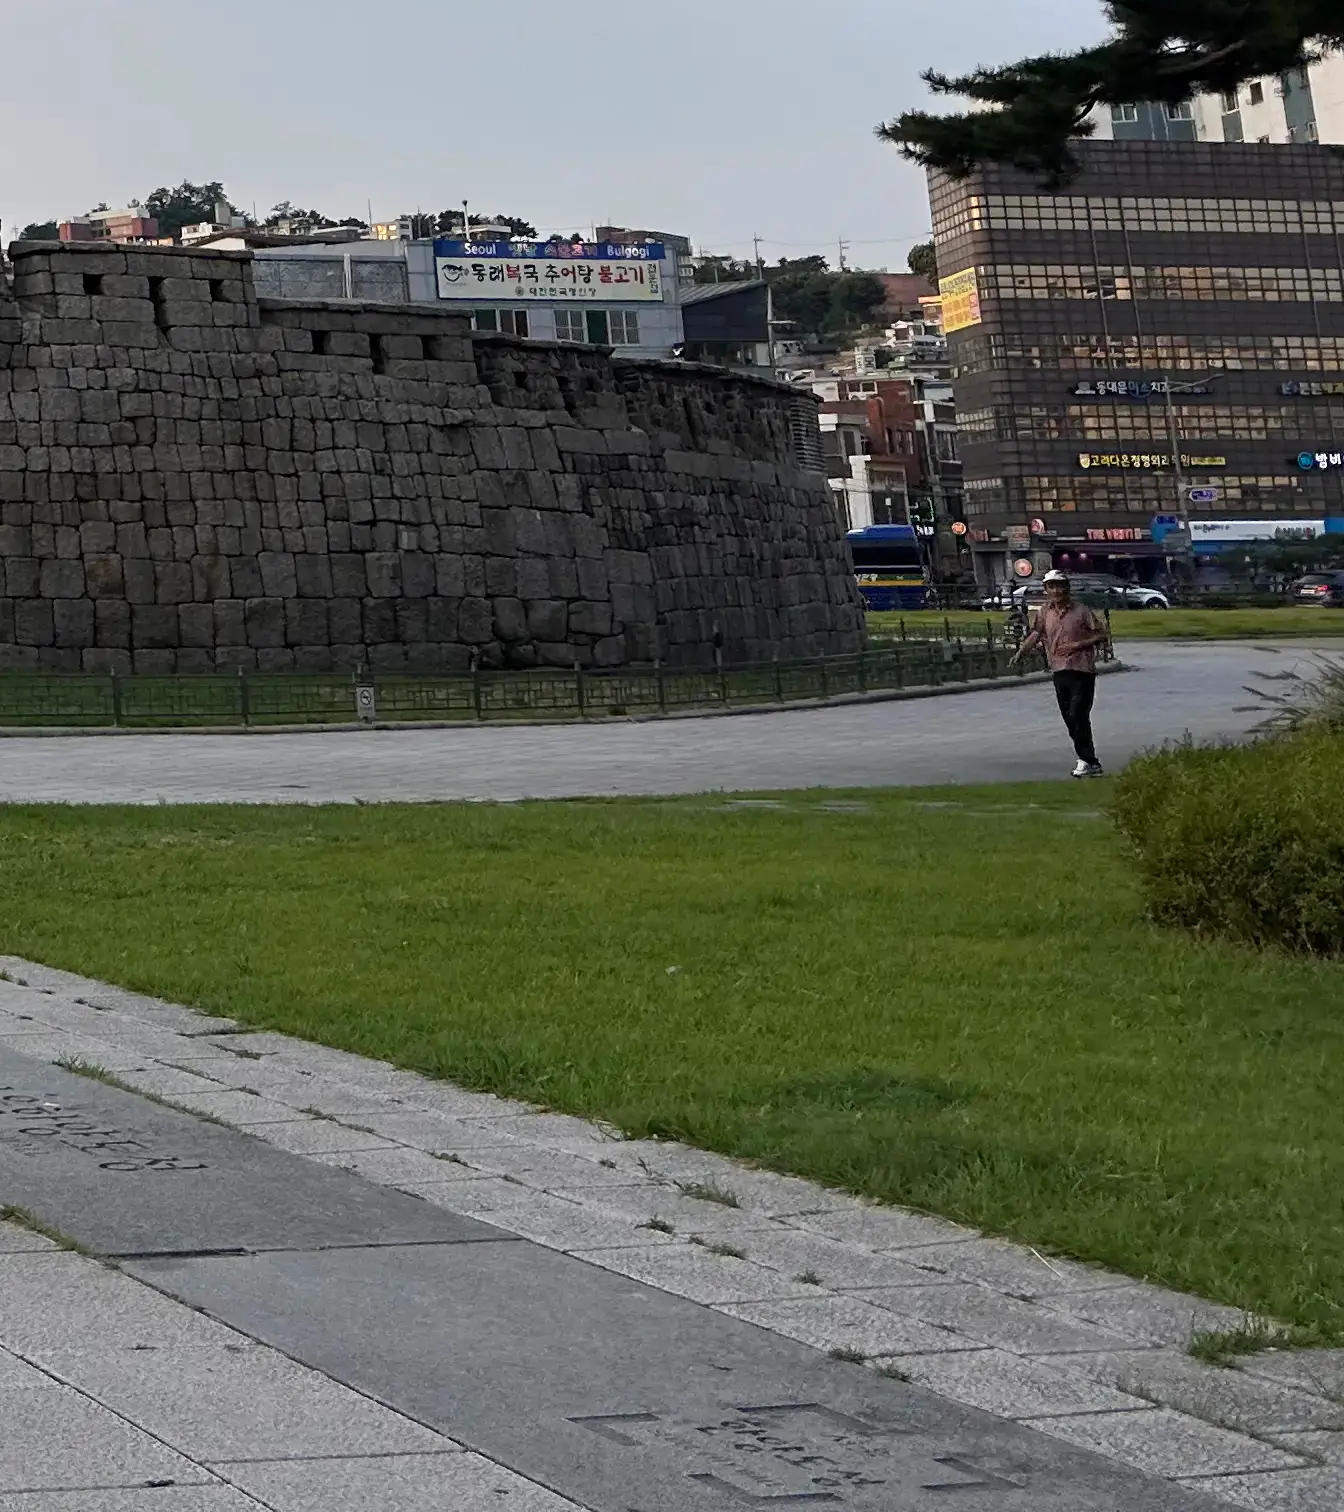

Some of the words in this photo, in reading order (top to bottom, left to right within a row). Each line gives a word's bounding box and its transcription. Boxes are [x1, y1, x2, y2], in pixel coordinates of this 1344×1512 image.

[464, 242, 497, 255] Seoul
[607, 245, 650, 259] Bulgogi
[545, 263, 595, 284] 추어탕
[598, 264, 645, 285] 불고기
